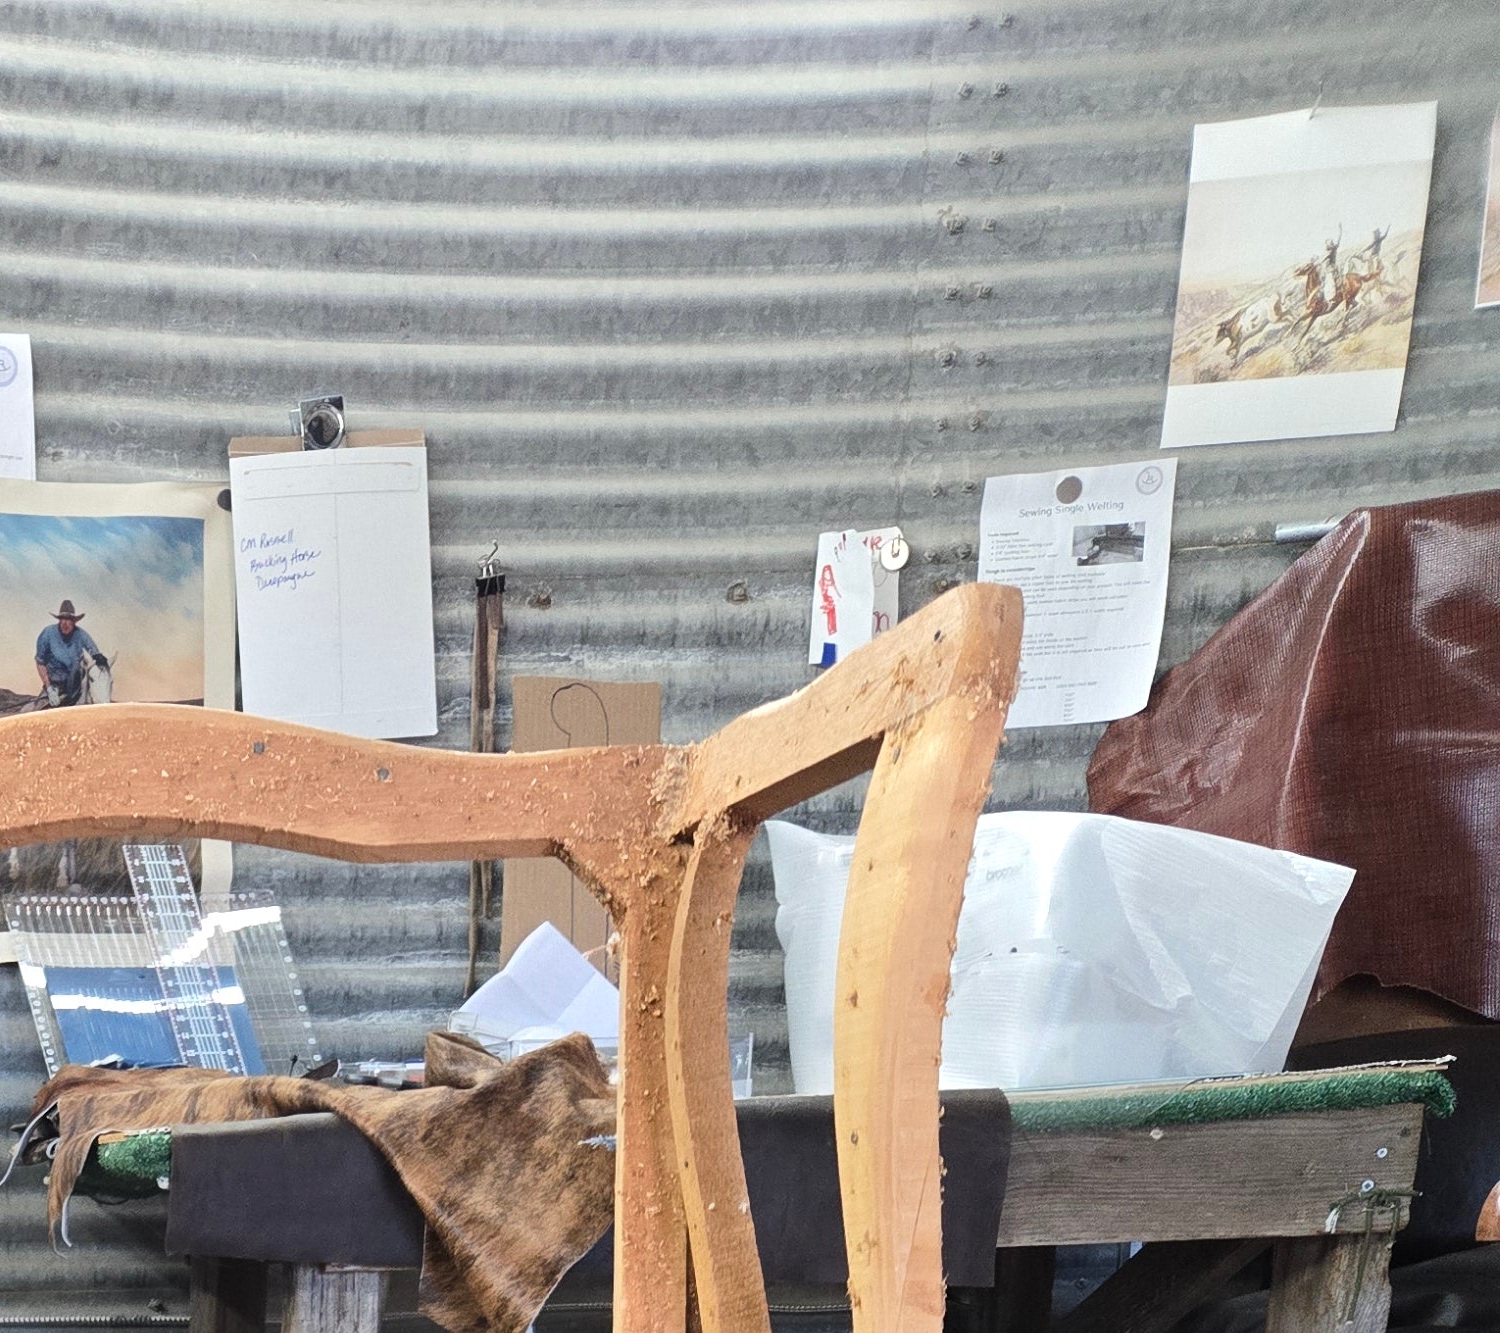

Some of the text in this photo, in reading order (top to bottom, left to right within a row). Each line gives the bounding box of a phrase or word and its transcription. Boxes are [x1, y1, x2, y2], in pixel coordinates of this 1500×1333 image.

[1019, 501, 1124, 518] Sewing Single Welting
[260, 528, 293, 548] Russell
